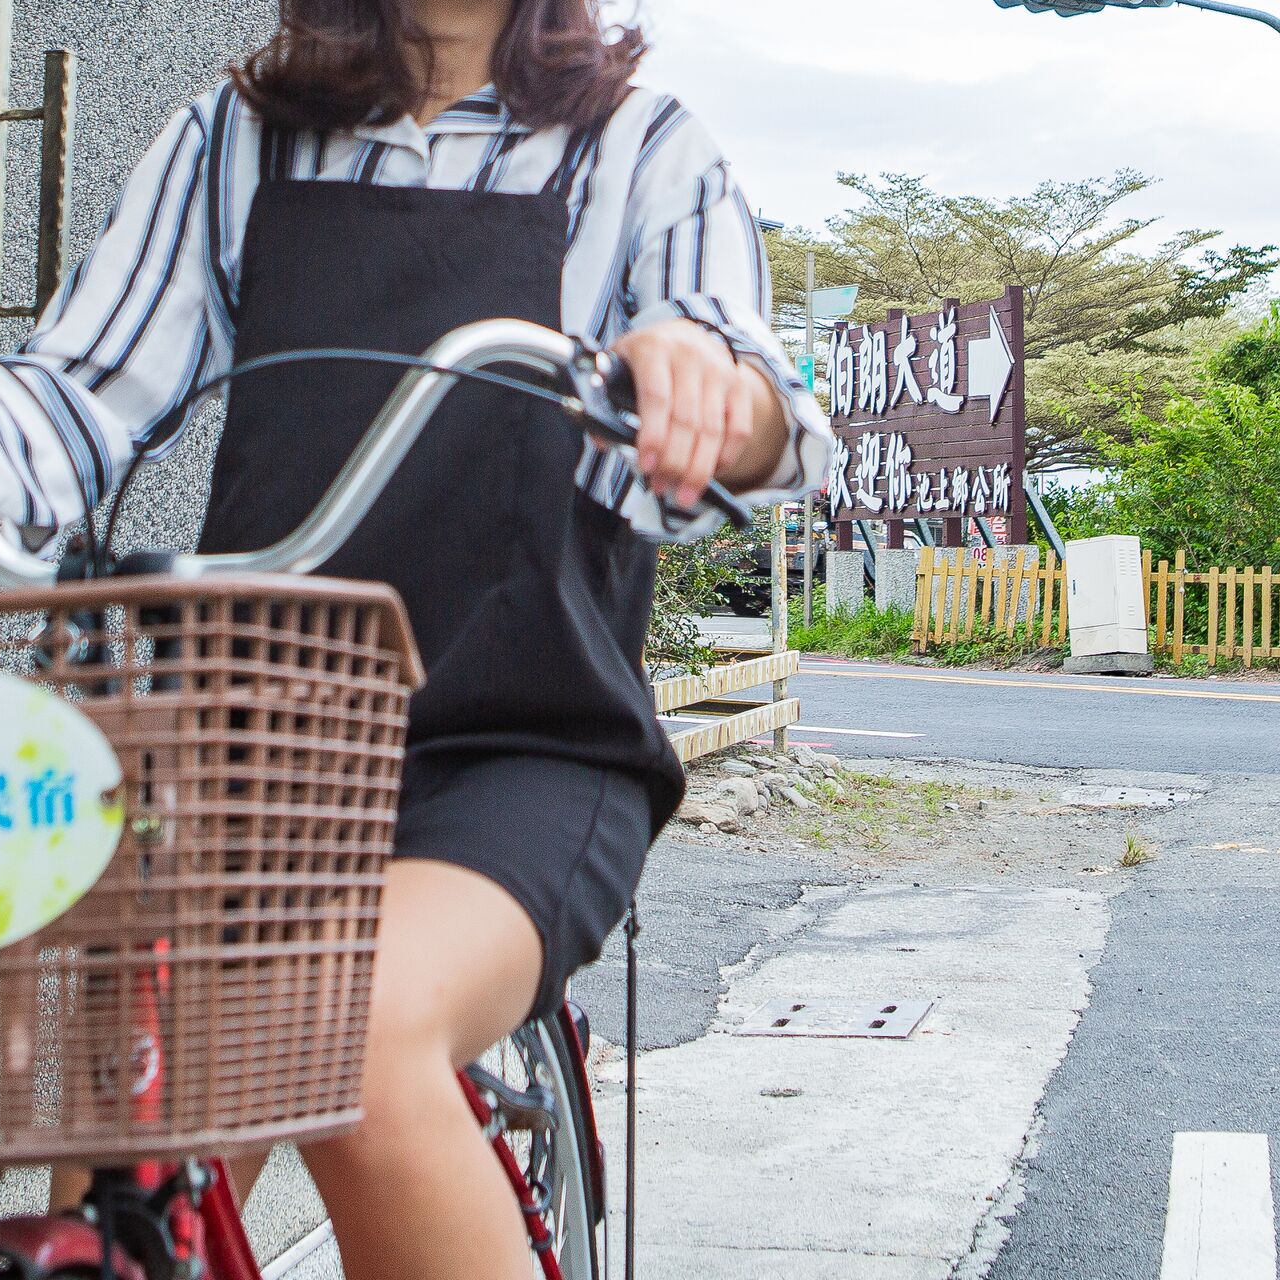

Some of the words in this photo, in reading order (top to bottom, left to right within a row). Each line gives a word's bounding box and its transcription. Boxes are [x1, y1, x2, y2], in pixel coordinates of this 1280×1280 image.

[826, 305, 964, 416] 伯朗大道
[917, 463, 1010, 514] 池上鄉公所
